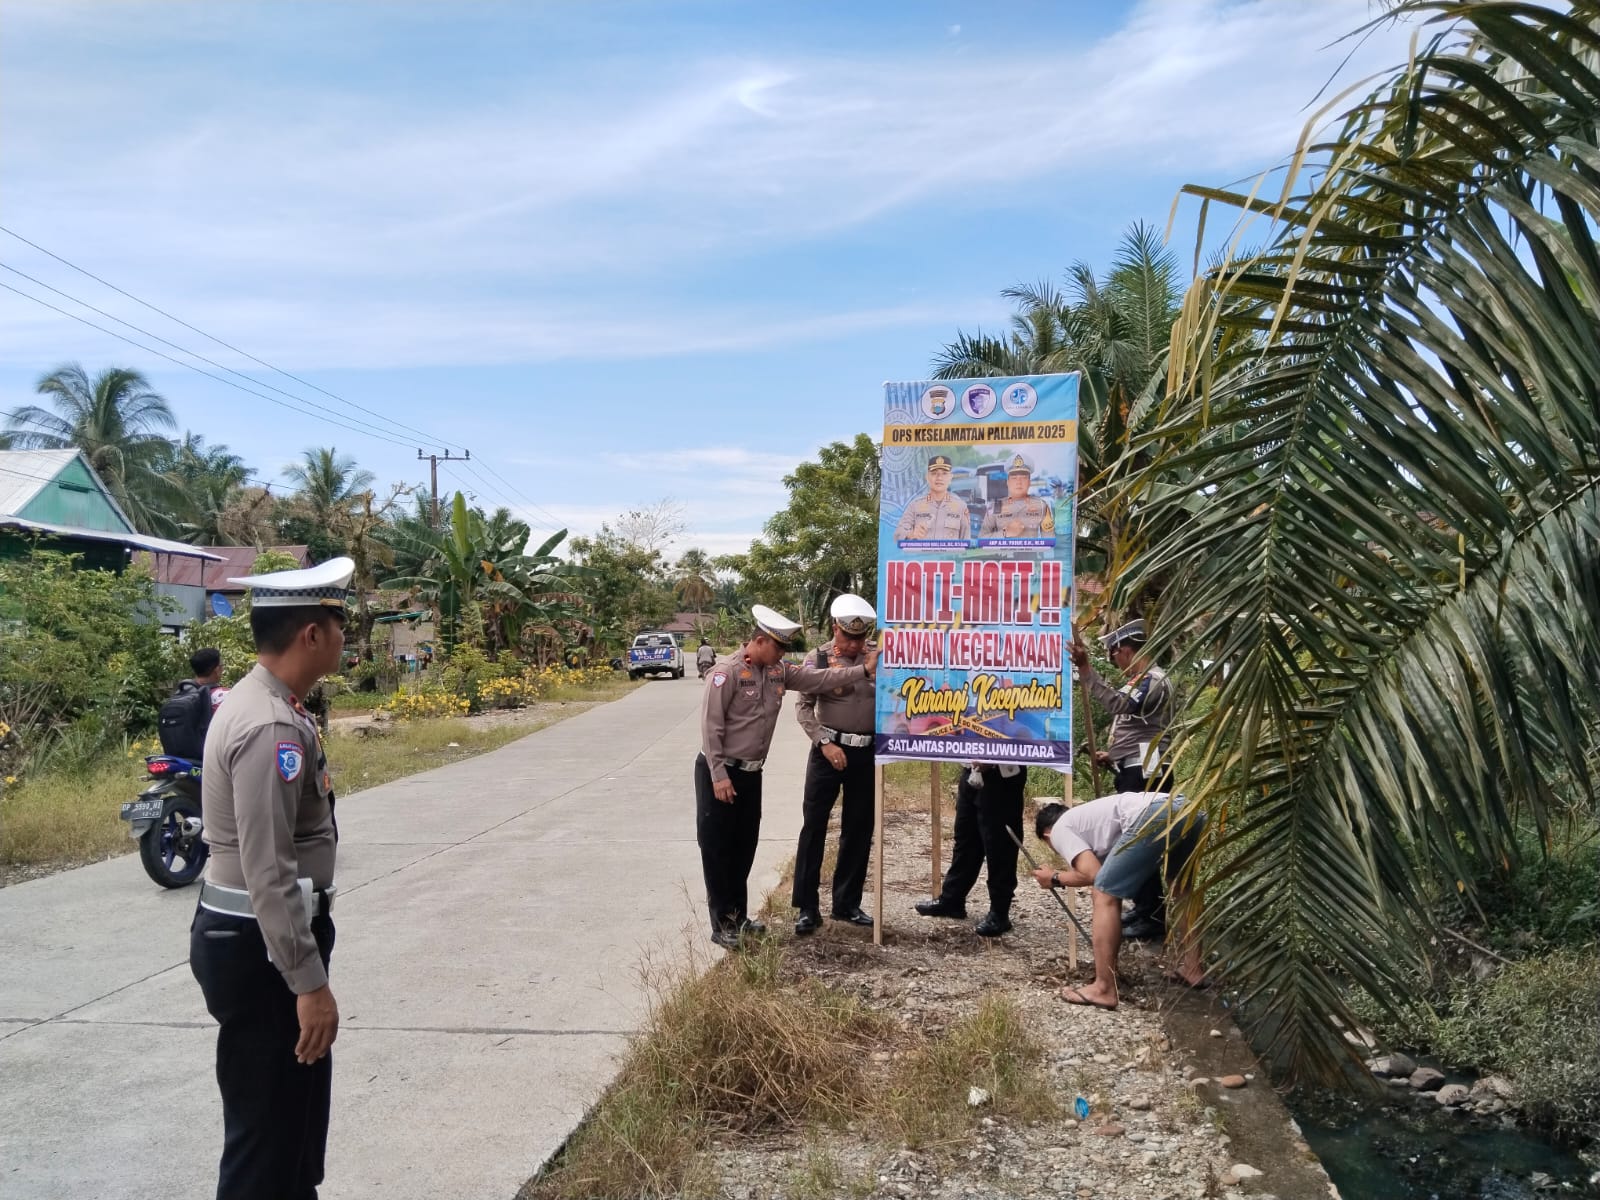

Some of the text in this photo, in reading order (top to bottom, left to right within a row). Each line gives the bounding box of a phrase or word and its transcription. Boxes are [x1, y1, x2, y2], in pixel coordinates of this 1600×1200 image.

[892, 424, 1066, 442] OPS KESELAMATAN PALLAWA 2025
[885, 560, 1062, 625] HATI-HATI !!
[883, 629, 1063, 672] RAWAN KECELAKAAN
[901, 673, 1062, 727] Kurangi Kecepatan!
[888, 738, 1055, 758] SATLANTAS POLRES LUWU UTARA
